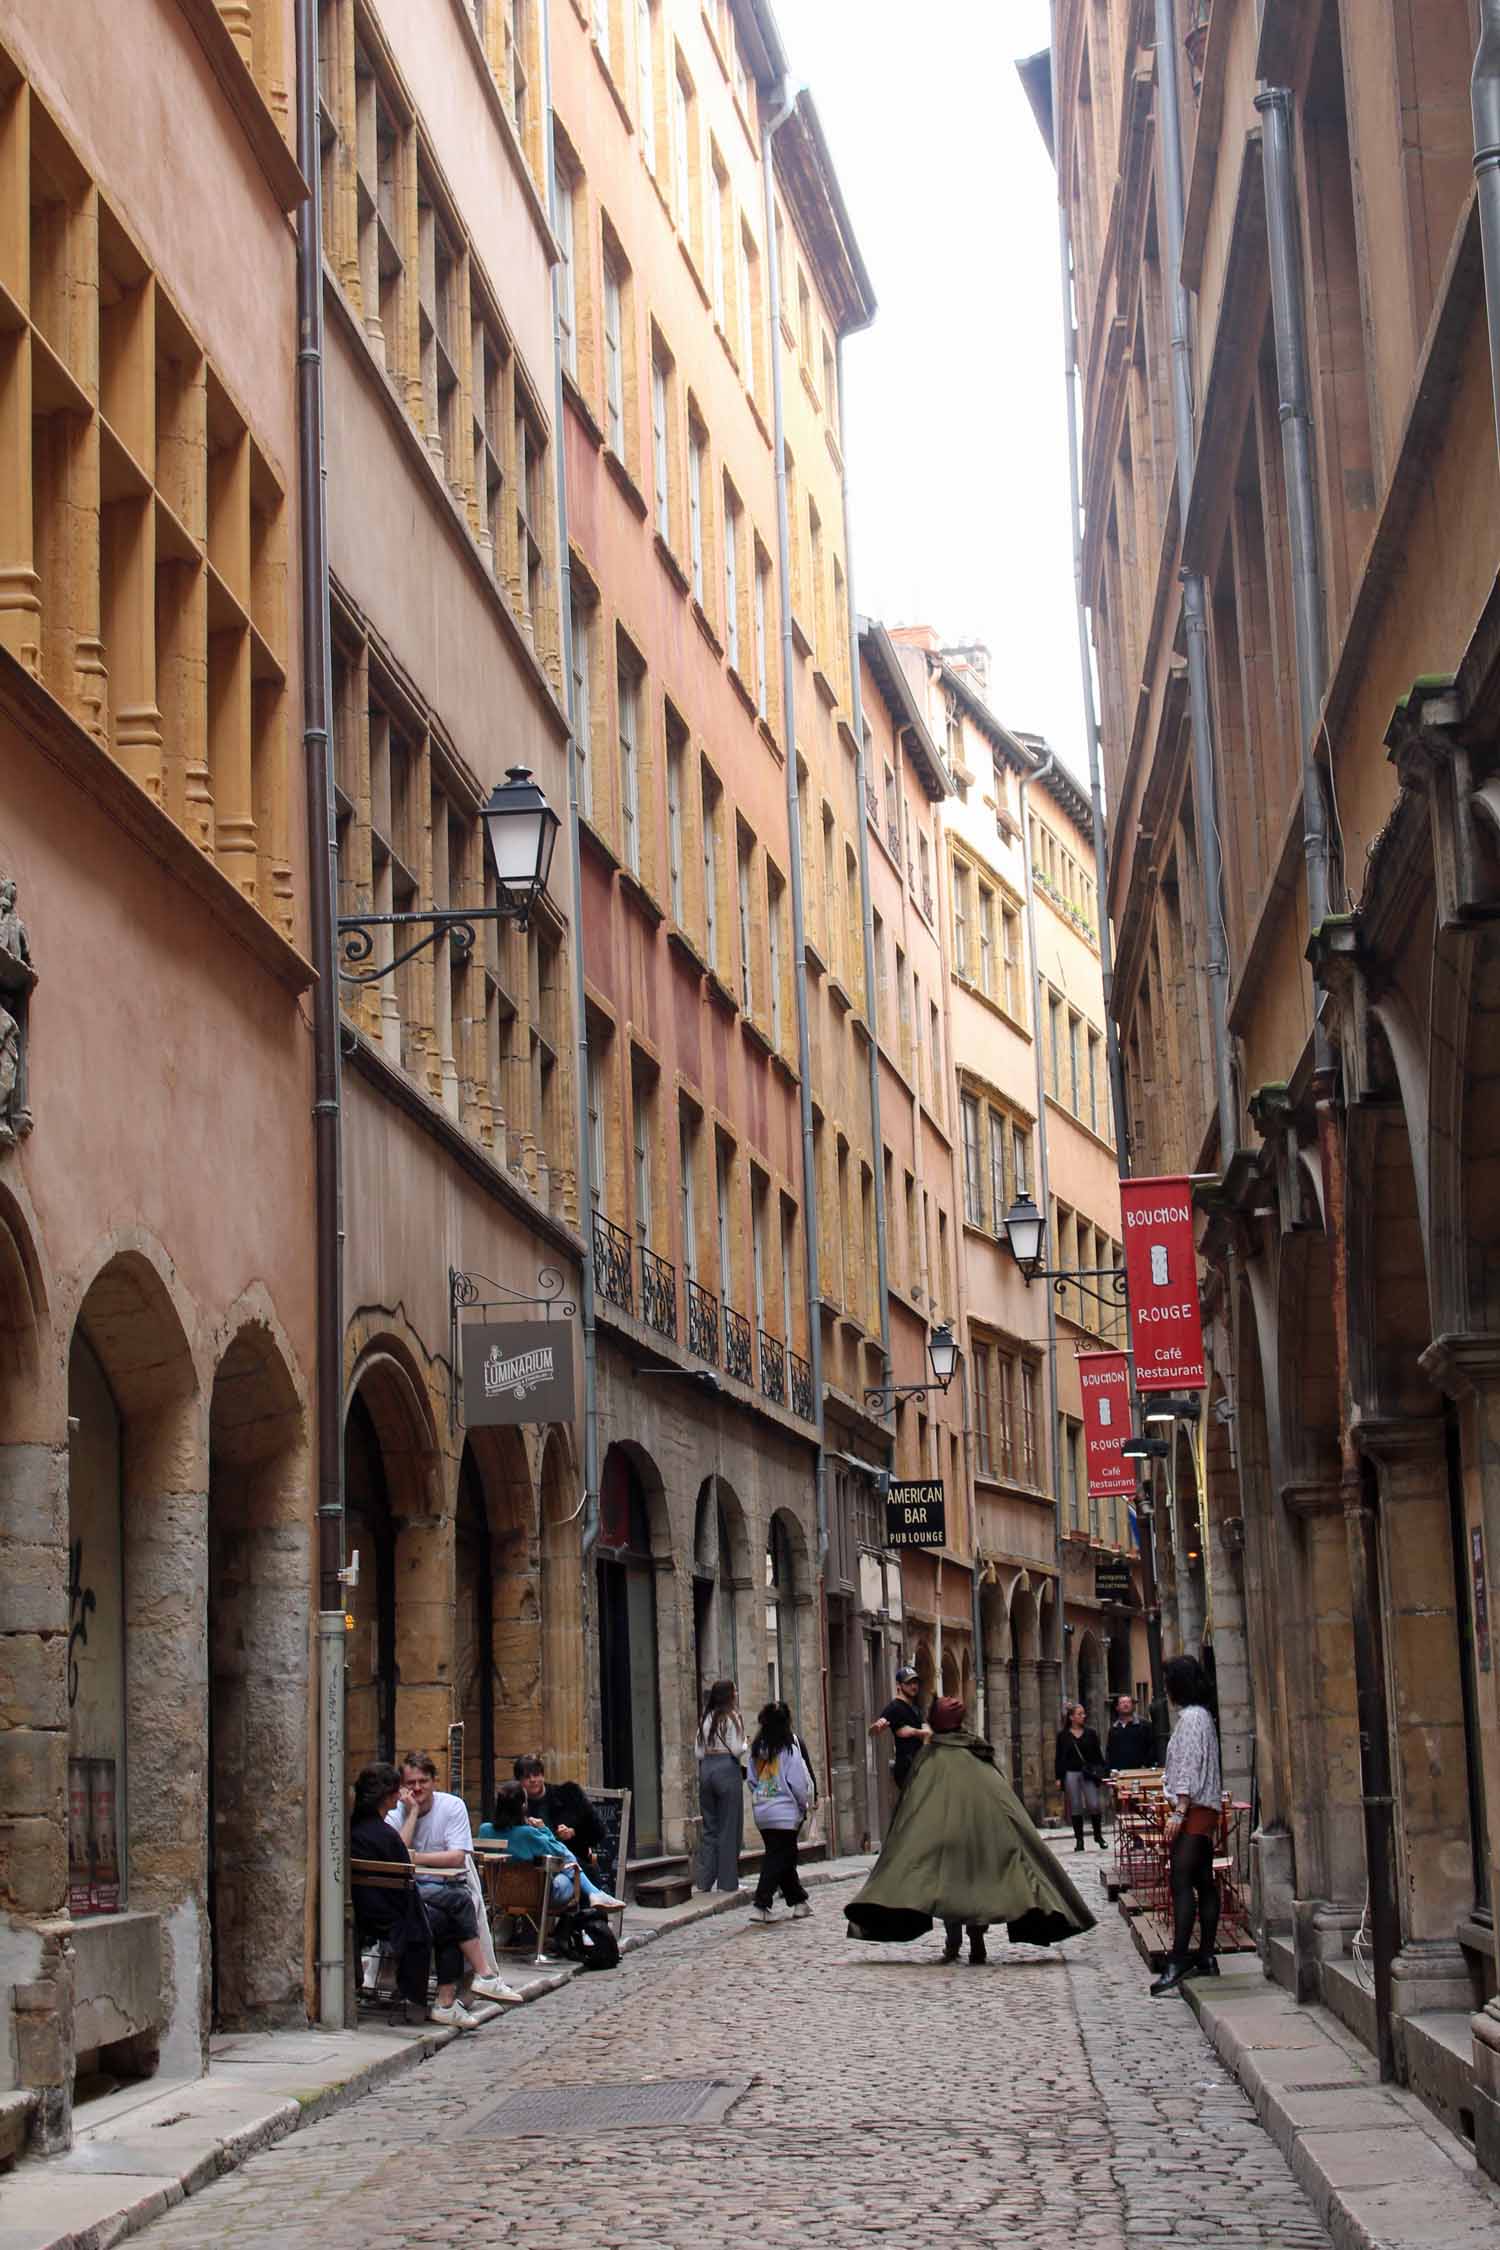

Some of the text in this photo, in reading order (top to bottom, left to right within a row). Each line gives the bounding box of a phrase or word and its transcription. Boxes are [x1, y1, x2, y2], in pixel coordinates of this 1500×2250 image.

[1127, 1205, 1189, 1227] BOUCHON
[1138, 1304, 1192, 1324] ROUGE
[1154, 1347, 1182, 1360] Café
[484, 1350, 553, 1386] LUMINARIUM
[1136, 1365, 1204, 1378] Restaurant
[1082, 1371, 1125, 1387] BOUCHON
[1091, 1438, 1127, 1452] ROUGE
[1102, 1466, 1121, 1476] Café
[1090, 1478, 1135, 1489] Restaurant
[887, 1486, 943, 1504] AMERICAN
[904, 1507, 928, 1524] BAR
[890, 1531, 944, 1544] PUB LOUNGE
